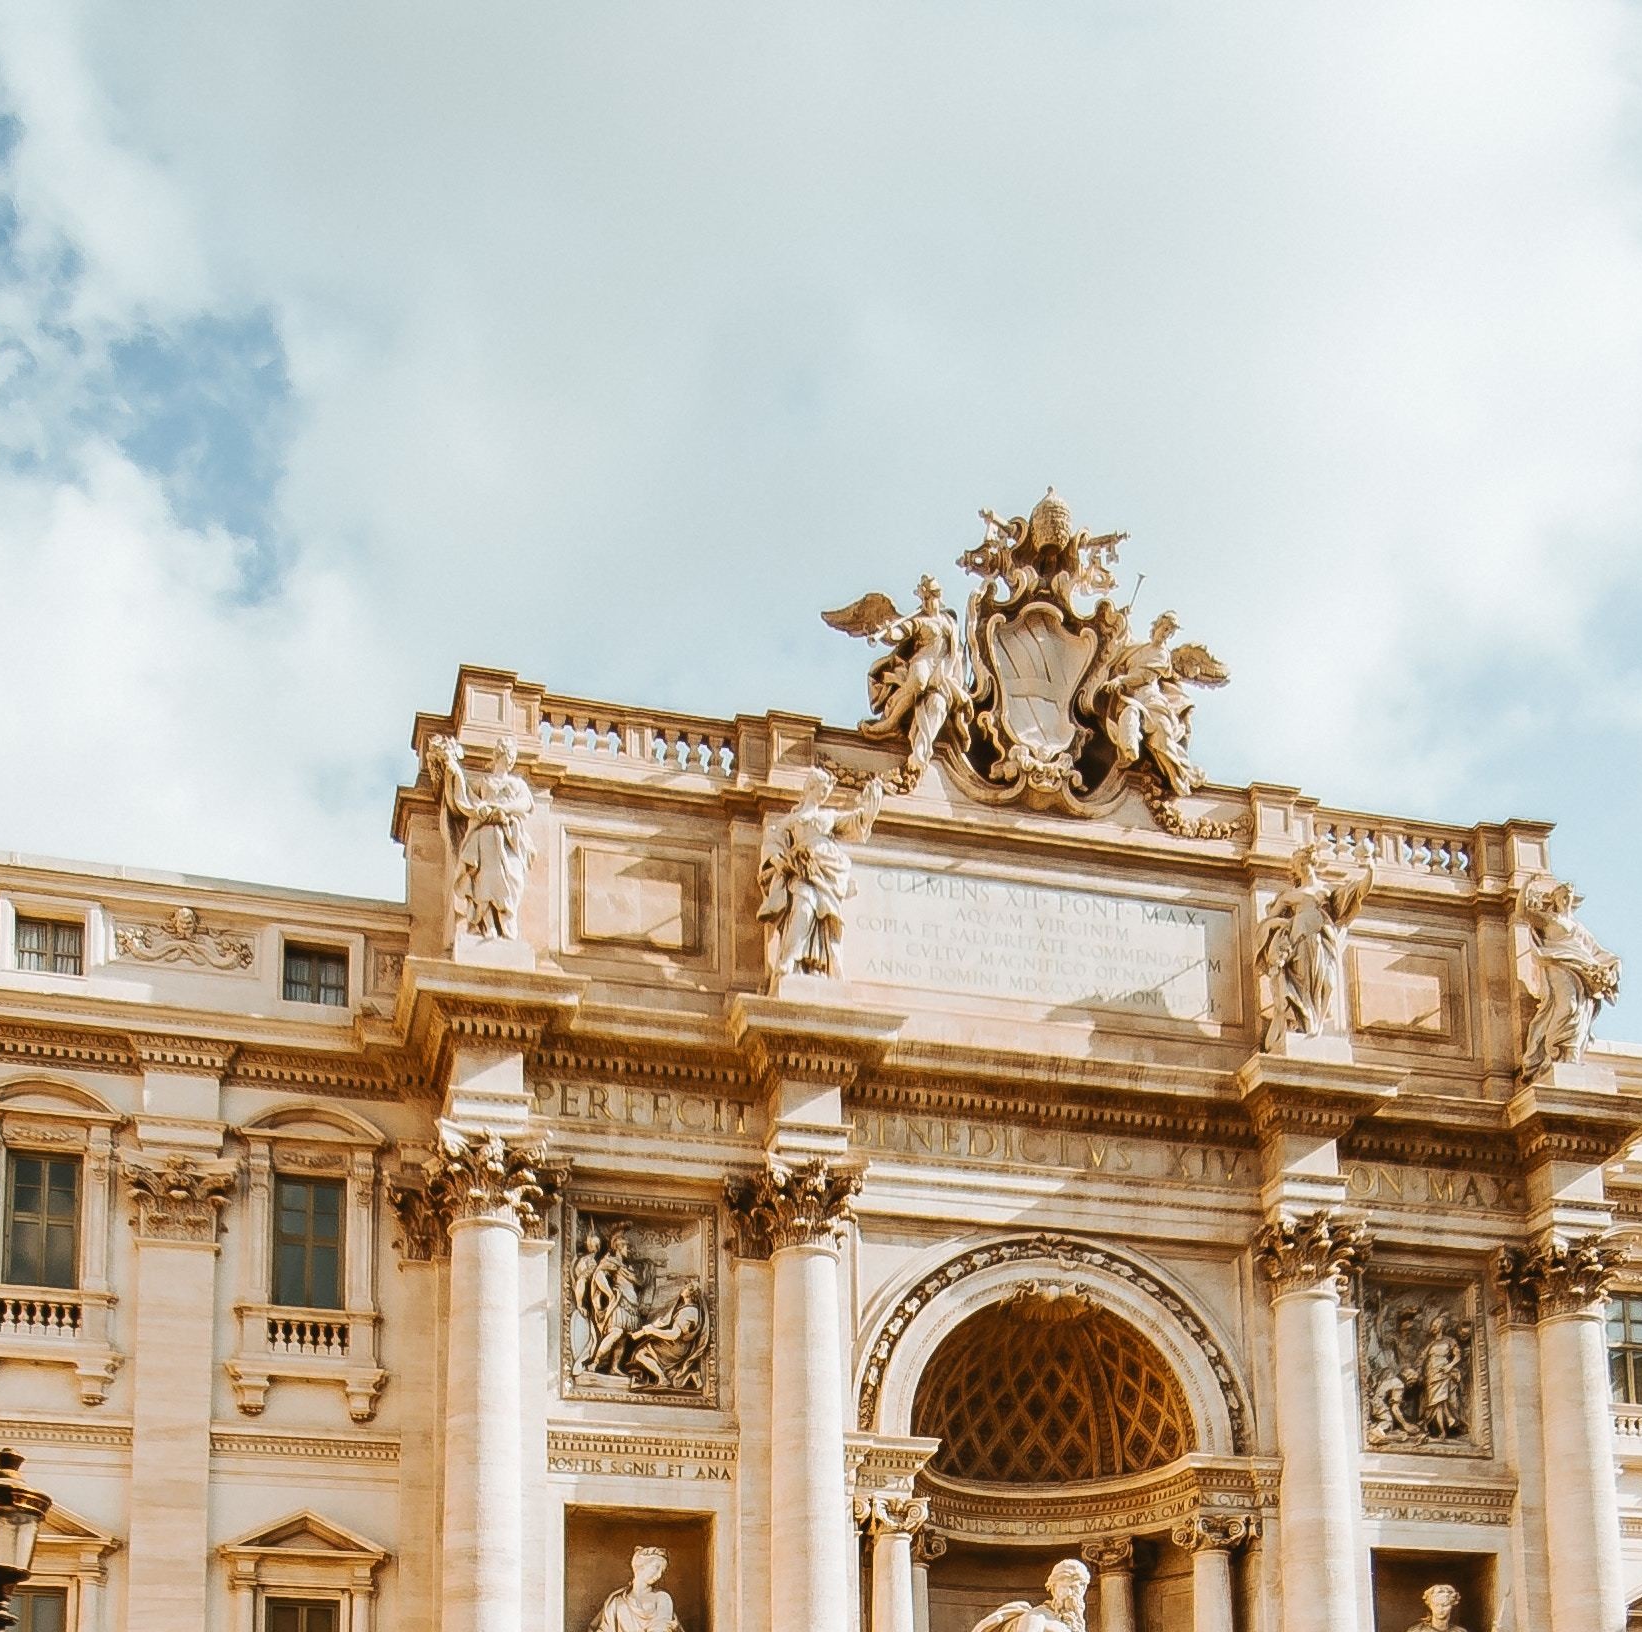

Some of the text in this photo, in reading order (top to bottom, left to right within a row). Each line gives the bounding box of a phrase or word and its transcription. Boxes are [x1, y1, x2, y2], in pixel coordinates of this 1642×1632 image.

[877, 872, 989, 902] CLEMENS
[856, 916, 912, 935] COPIA
[922, 923, 942, 938] ET
[950, 927, 1066, 954] SALVBRITATE
[956, 907, 1129, 942] AQVAM VIRGINEM
[866, 959, 922, 978] ANNO
[930, 966, 999, 987] DOMINI
[906, 943, 966, 961] CVLTV
[980, 951, 1087, 976] MAGNIFICO
[531, 1080, 755, 1135] PERFECIT
[850, 1112, 1133, 1170] BENEDICTVS
[1348, 1166, 1403, 1198] ON
[667, 1462, 685, 1478] ET
[694, 1465, 732, 1480] ANA
[1125, 1509, 1157, 1527] OPVS
[1161, 1502, 1186, 1520] CVM
